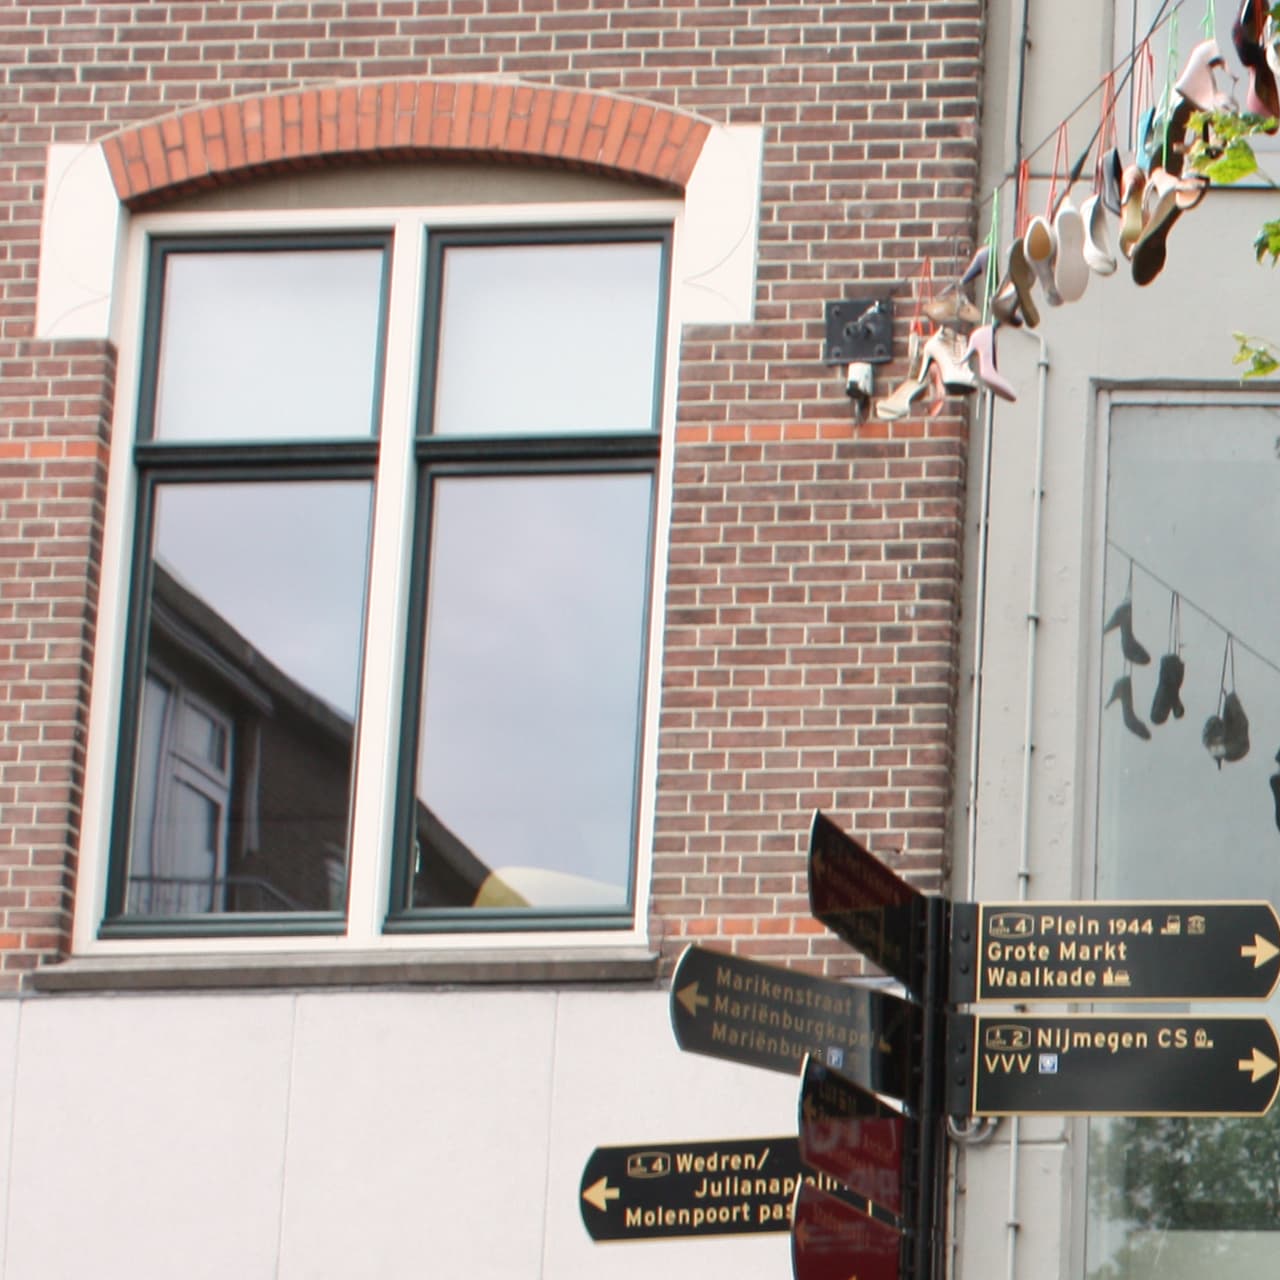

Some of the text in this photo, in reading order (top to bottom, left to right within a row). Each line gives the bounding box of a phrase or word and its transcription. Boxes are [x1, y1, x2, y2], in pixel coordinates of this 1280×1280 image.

[1040, 916, 1100, 935] Plein
[1108, 918, 1153, 935] 1944
[987, 941, 1128, 961] Grote Markt
[987, 966, 1096, 986] Waalkade
[716, 967, 851, 1015] Marikenstraat
[1037, 1028, 1148, 1053] Nijmegen
[1157, 1029, 1188, 1048] CS
[984, 1054, 1031, 1074] VVV
[675, 1147, 770, 1173] Wedren/
[694, 1171, 838, 1199] Julianapein
[625, 1203, 750, 1227] Molenpoort
[758, 1202, 795, 1225] pas
